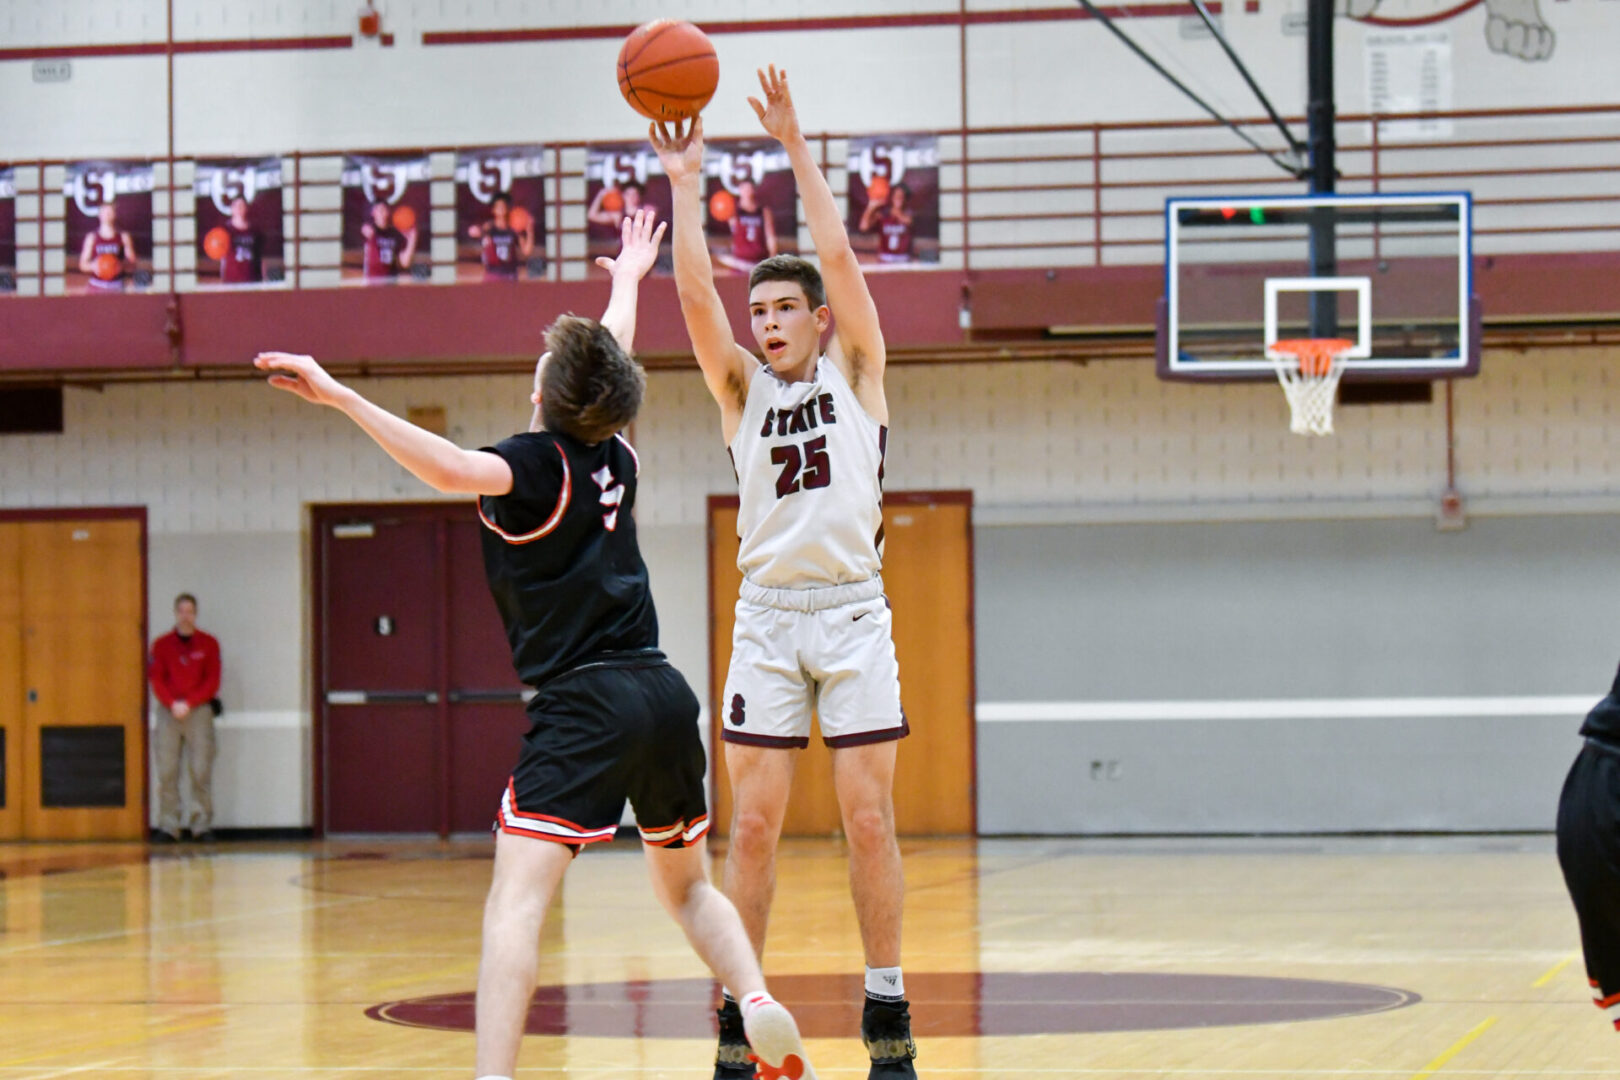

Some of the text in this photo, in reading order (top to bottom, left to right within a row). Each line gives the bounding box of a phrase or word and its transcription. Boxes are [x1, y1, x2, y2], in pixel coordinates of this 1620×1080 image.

[760, 392, 837, 438] STATE
[770, 434, 832, 500] 25
[730, 693, 746, 727] S
